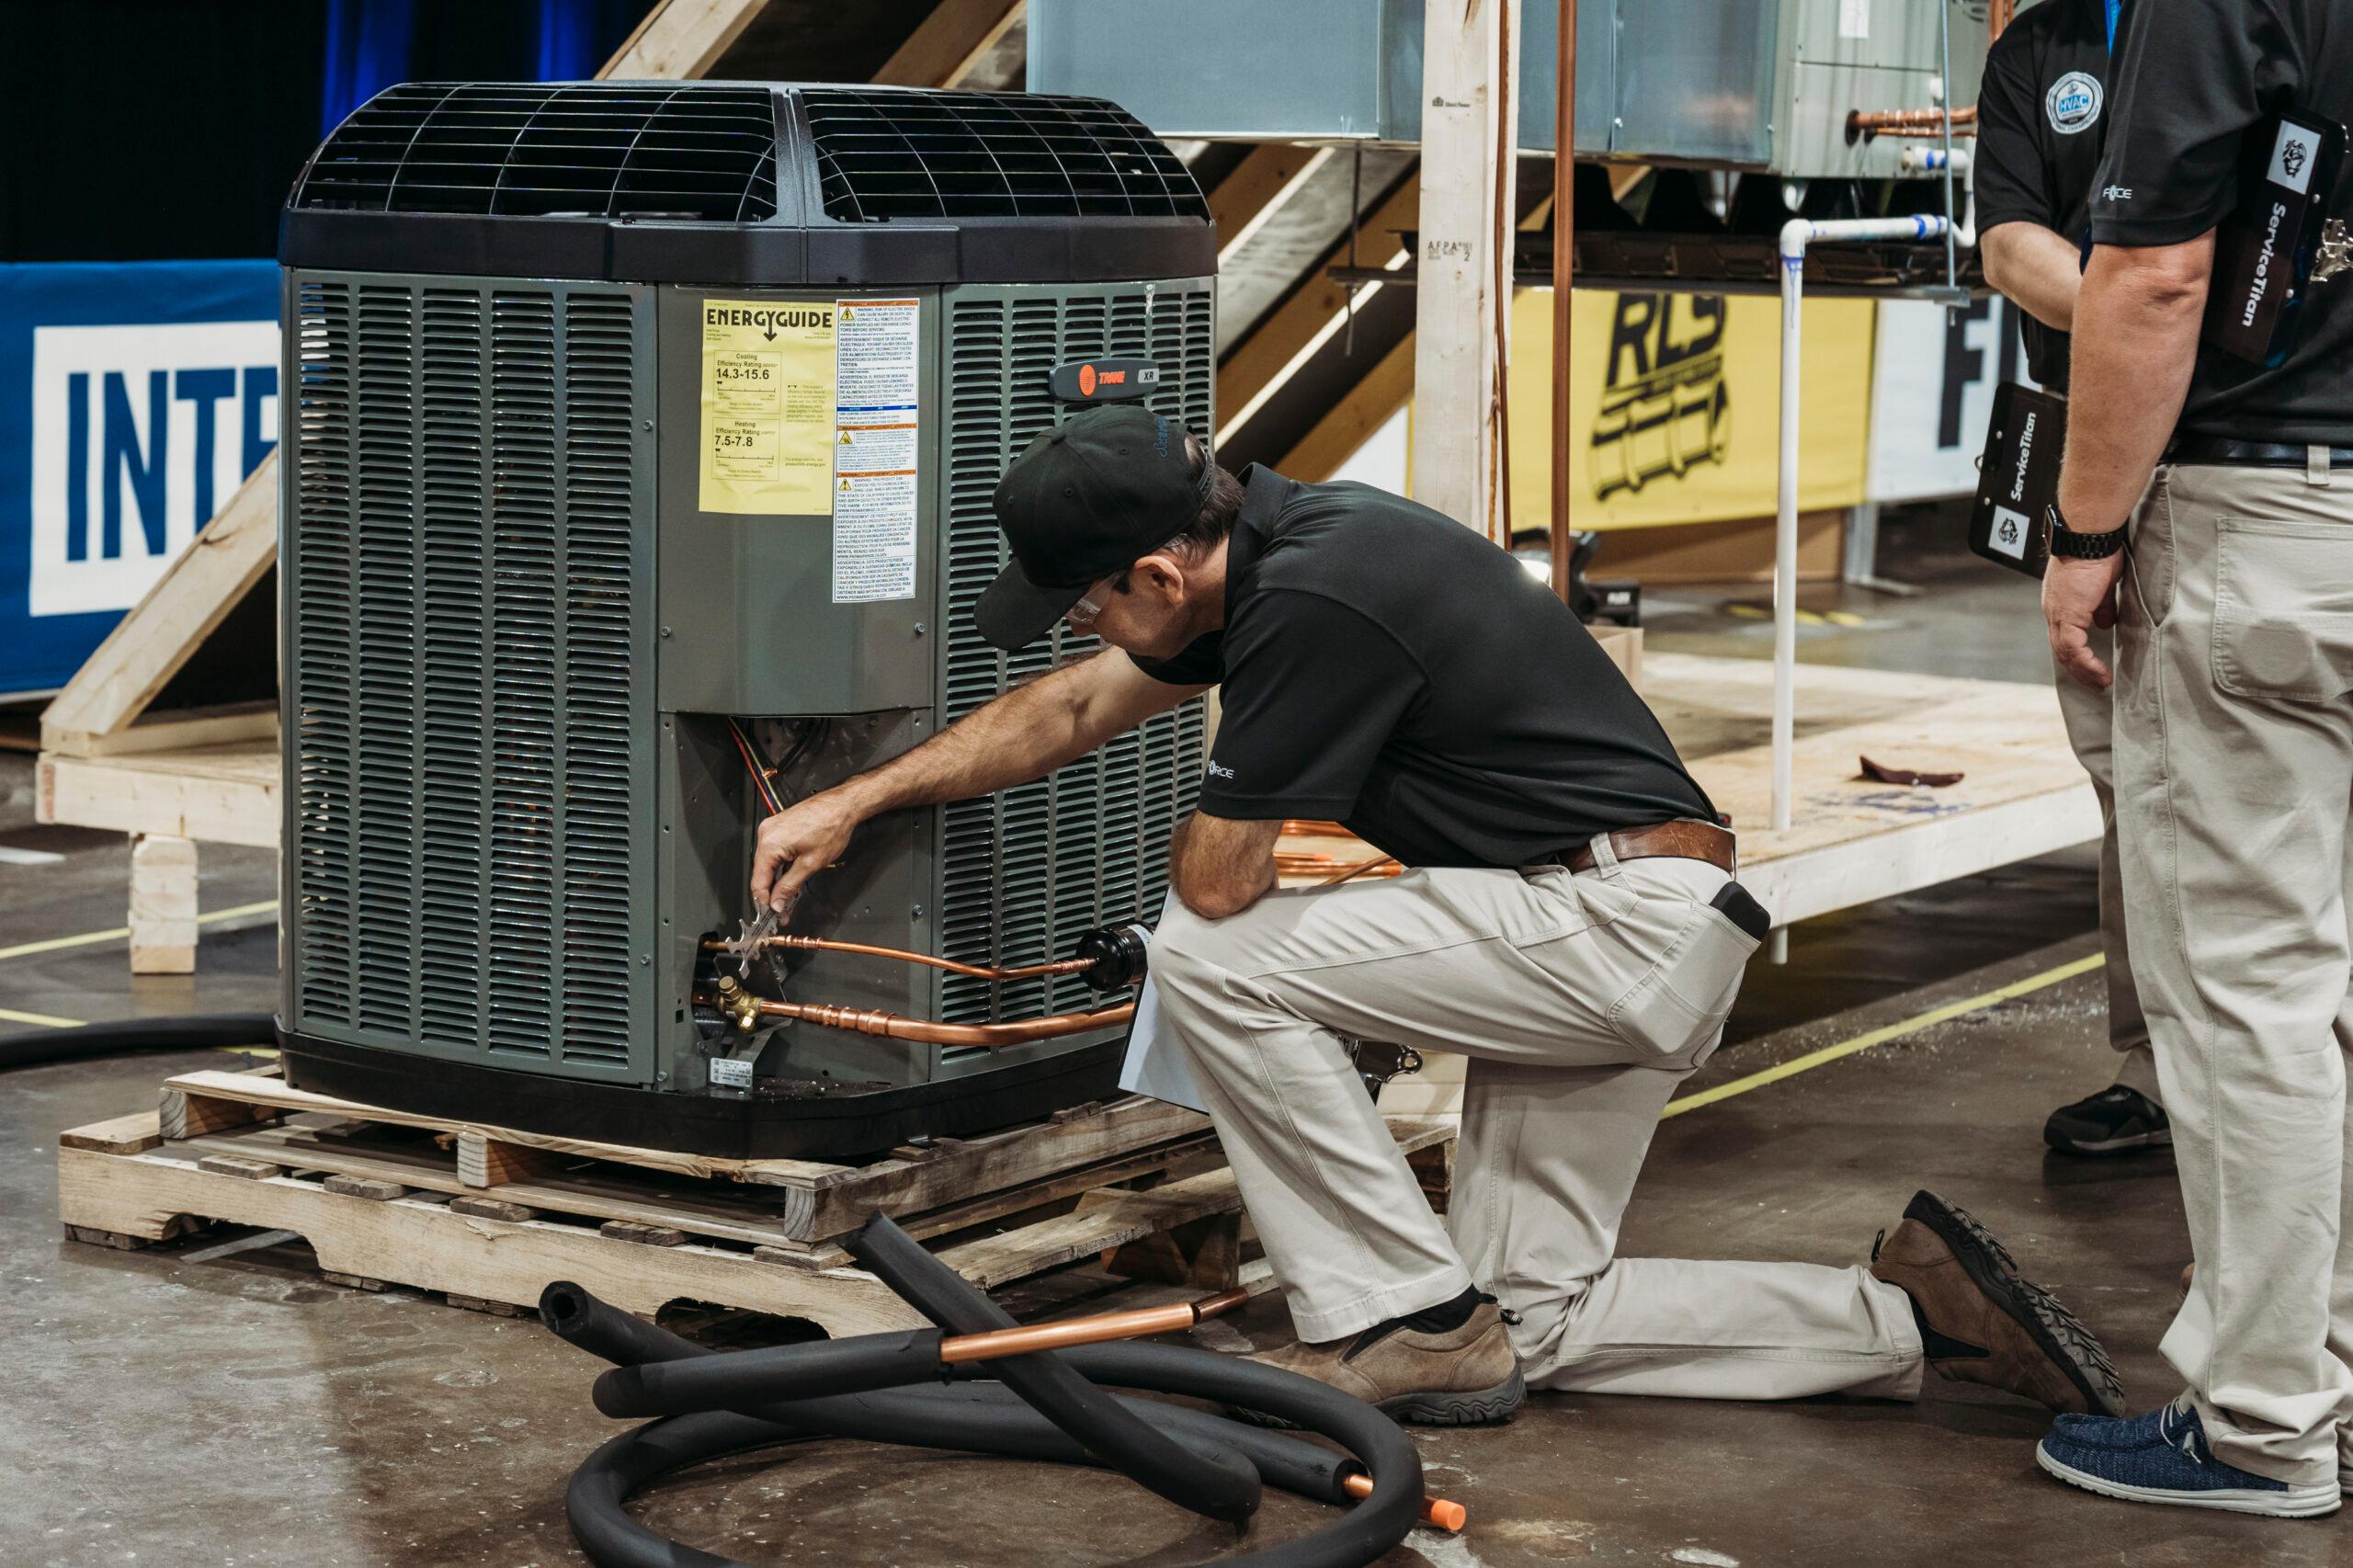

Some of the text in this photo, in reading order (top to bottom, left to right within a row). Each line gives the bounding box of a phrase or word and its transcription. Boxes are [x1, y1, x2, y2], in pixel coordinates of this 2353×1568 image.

[2060, 95, 2088, 112] HVAC
[2242, 201, 2287, 327] ServiceTitan
[707, 309, 833, 335] ENERGYGUIDE
[1607, 292, 1725, 388] RLS
[717, 359, 742, 368] Efficiency
[716, 368, 769, 380] 14.3-15.6
[1143, 371, 1154, 381] XR
[715, 435, 753, 447] 7.5-7.8
[2011, 413, 2036, 502] ServiceTitan
